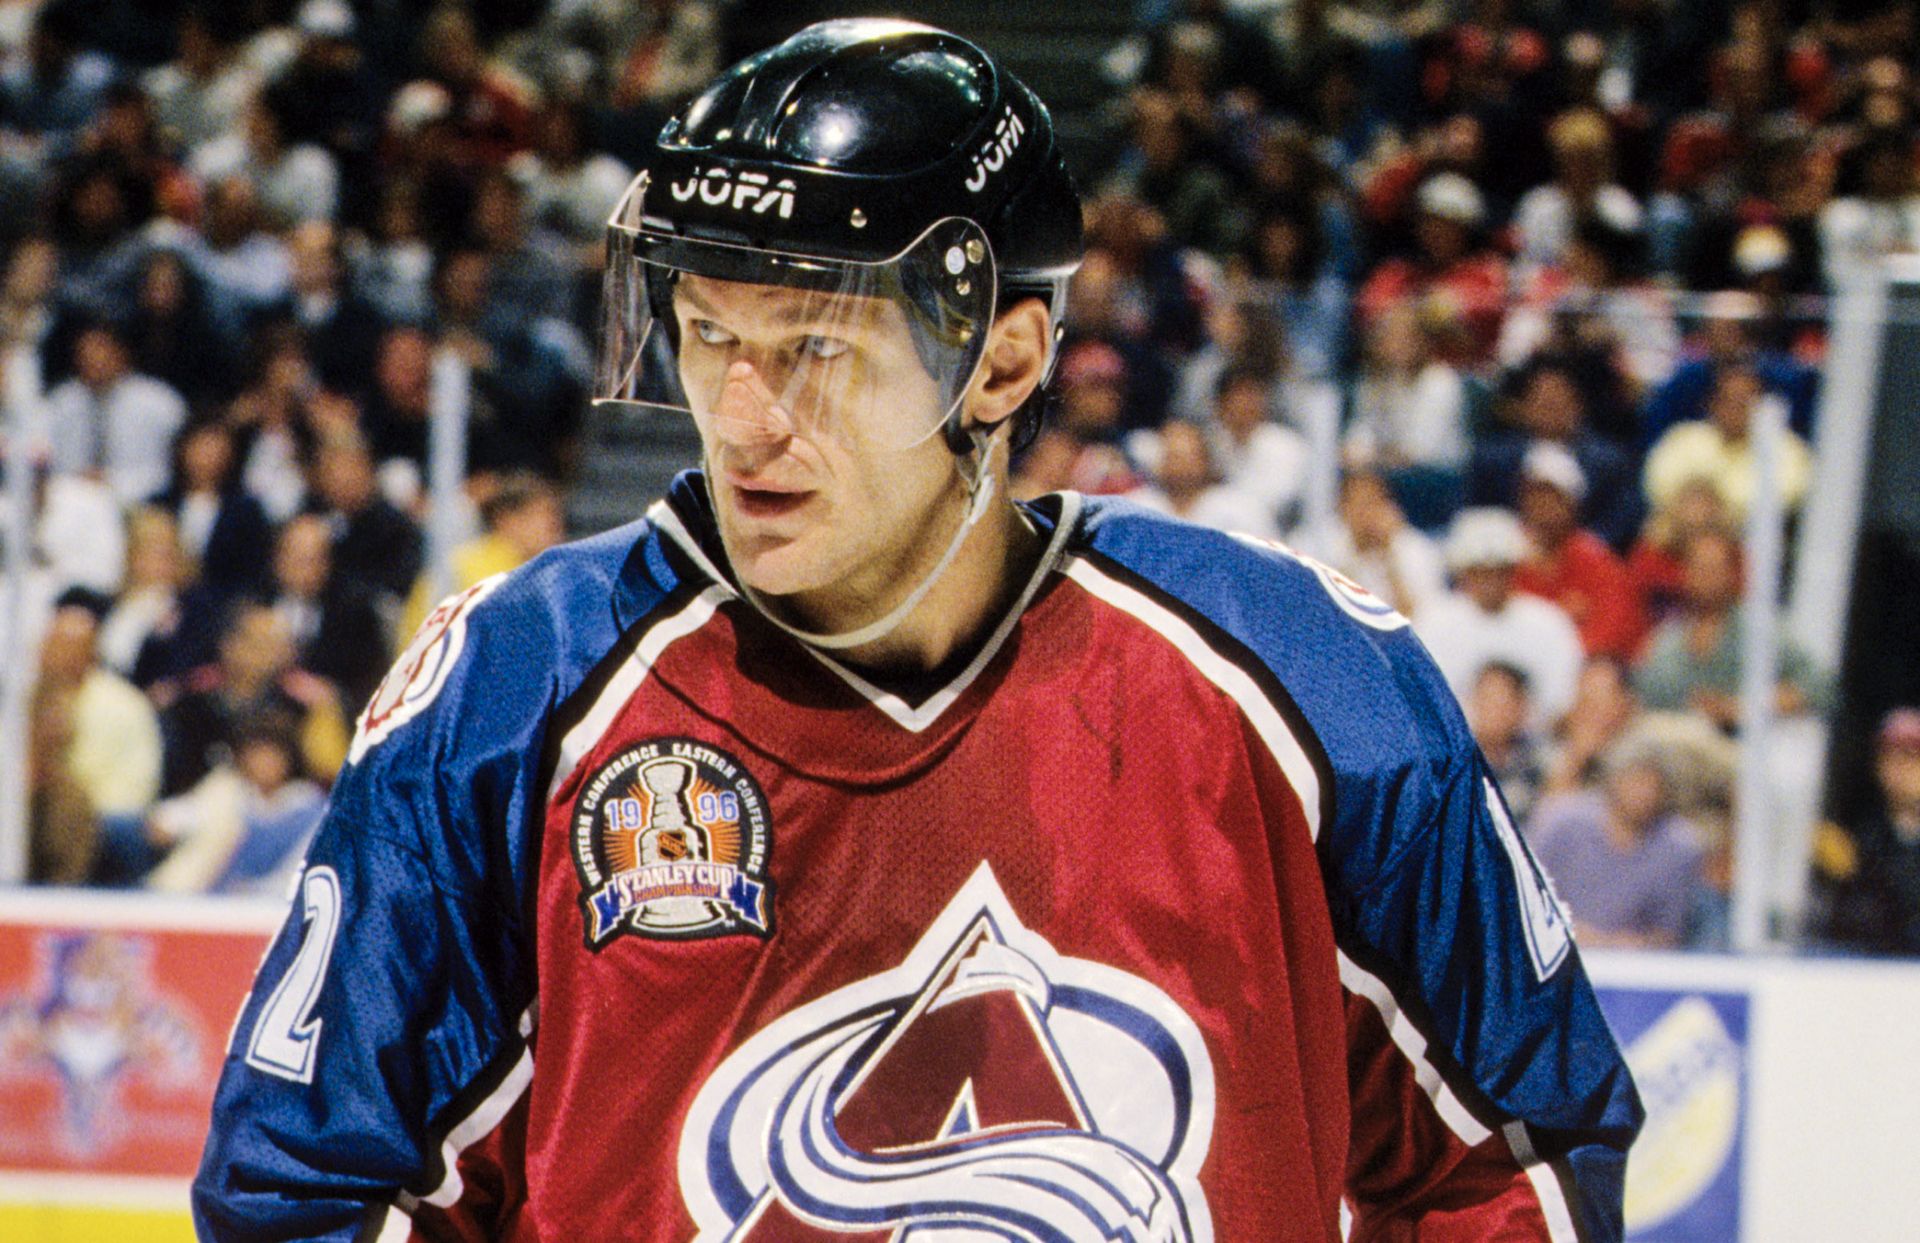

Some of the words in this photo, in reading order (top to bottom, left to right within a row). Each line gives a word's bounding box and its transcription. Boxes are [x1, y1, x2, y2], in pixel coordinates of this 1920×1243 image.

[965, 105, 1025, 193] JOFA
[671, 166, 797, 219] JOFA
[583, 744, 659, 811] CONFERENCE
[604, 798, 641, 831] 19
[698, 791, 739, 824] 96
[672, 743, 737, 779] EASTERN
[735, 778, 766, 875] CONFERENCE
[578, 814, 602, 887] WESTERN
[618, 864, 695, 909] STANLEY
[696, 864, 733, 900] CUP
[224, 862, 341, 1084] 2
